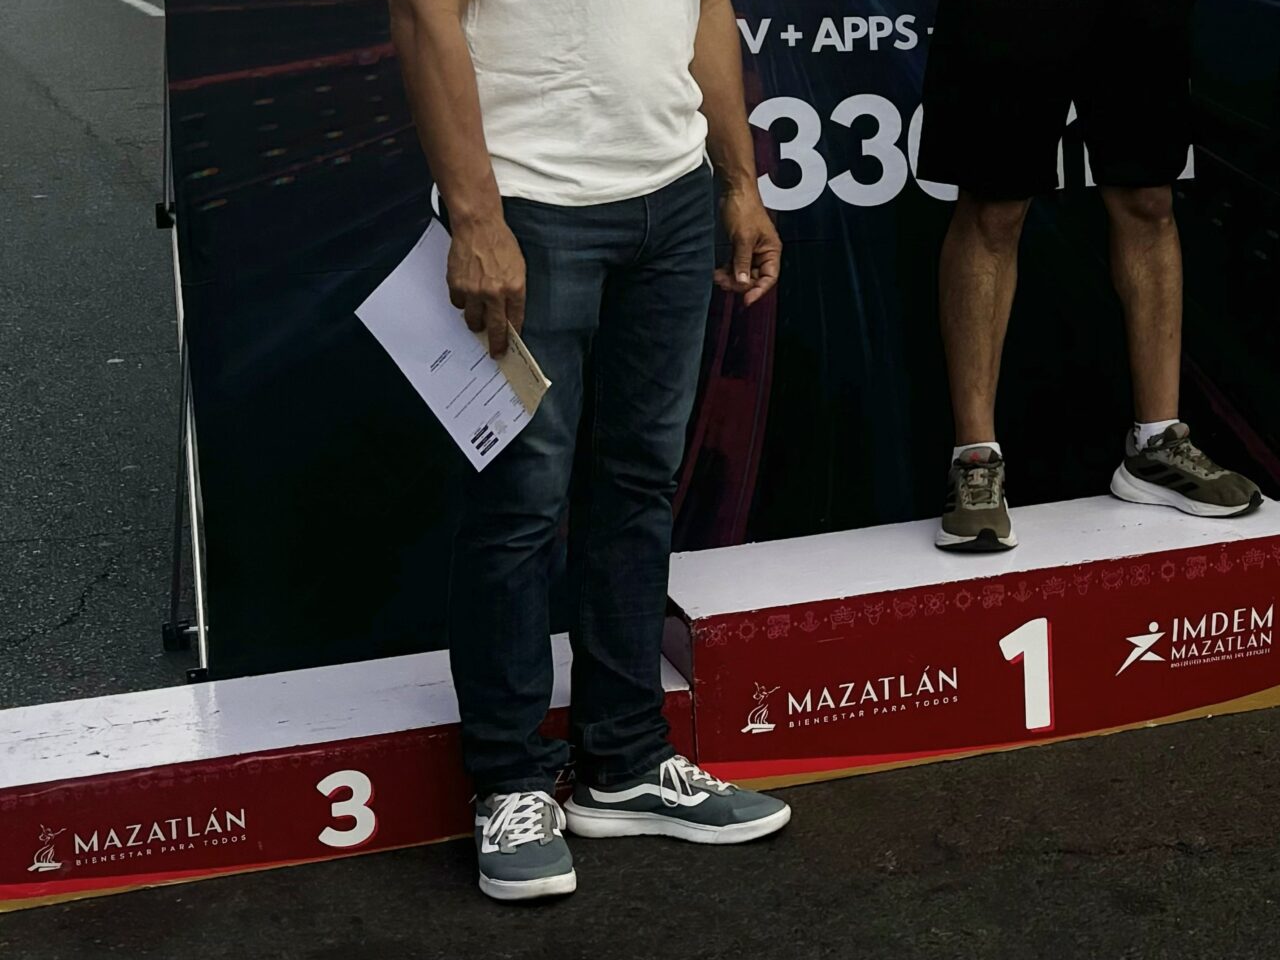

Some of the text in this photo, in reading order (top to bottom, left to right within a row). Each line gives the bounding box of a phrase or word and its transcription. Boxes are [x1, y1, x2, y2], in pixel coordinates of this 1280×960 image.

[811, 14, 918, 53] APPS
[1172, 603, 1274, 642] IMDEM
[1171, 630, 1273, 661] MAZATLÁN
[788, 665, 959, 716] MAZATLÁN
[999, 617, 1051, 730] 1
[789, 695, 959, 728] BIENESTAR PARA TODOS
[316, 769, 376, 847] 3
[73, 807, 247, 855] MAZATLÁN
[75, 834, 247, 866] BIENESTAR PARA TODOS
